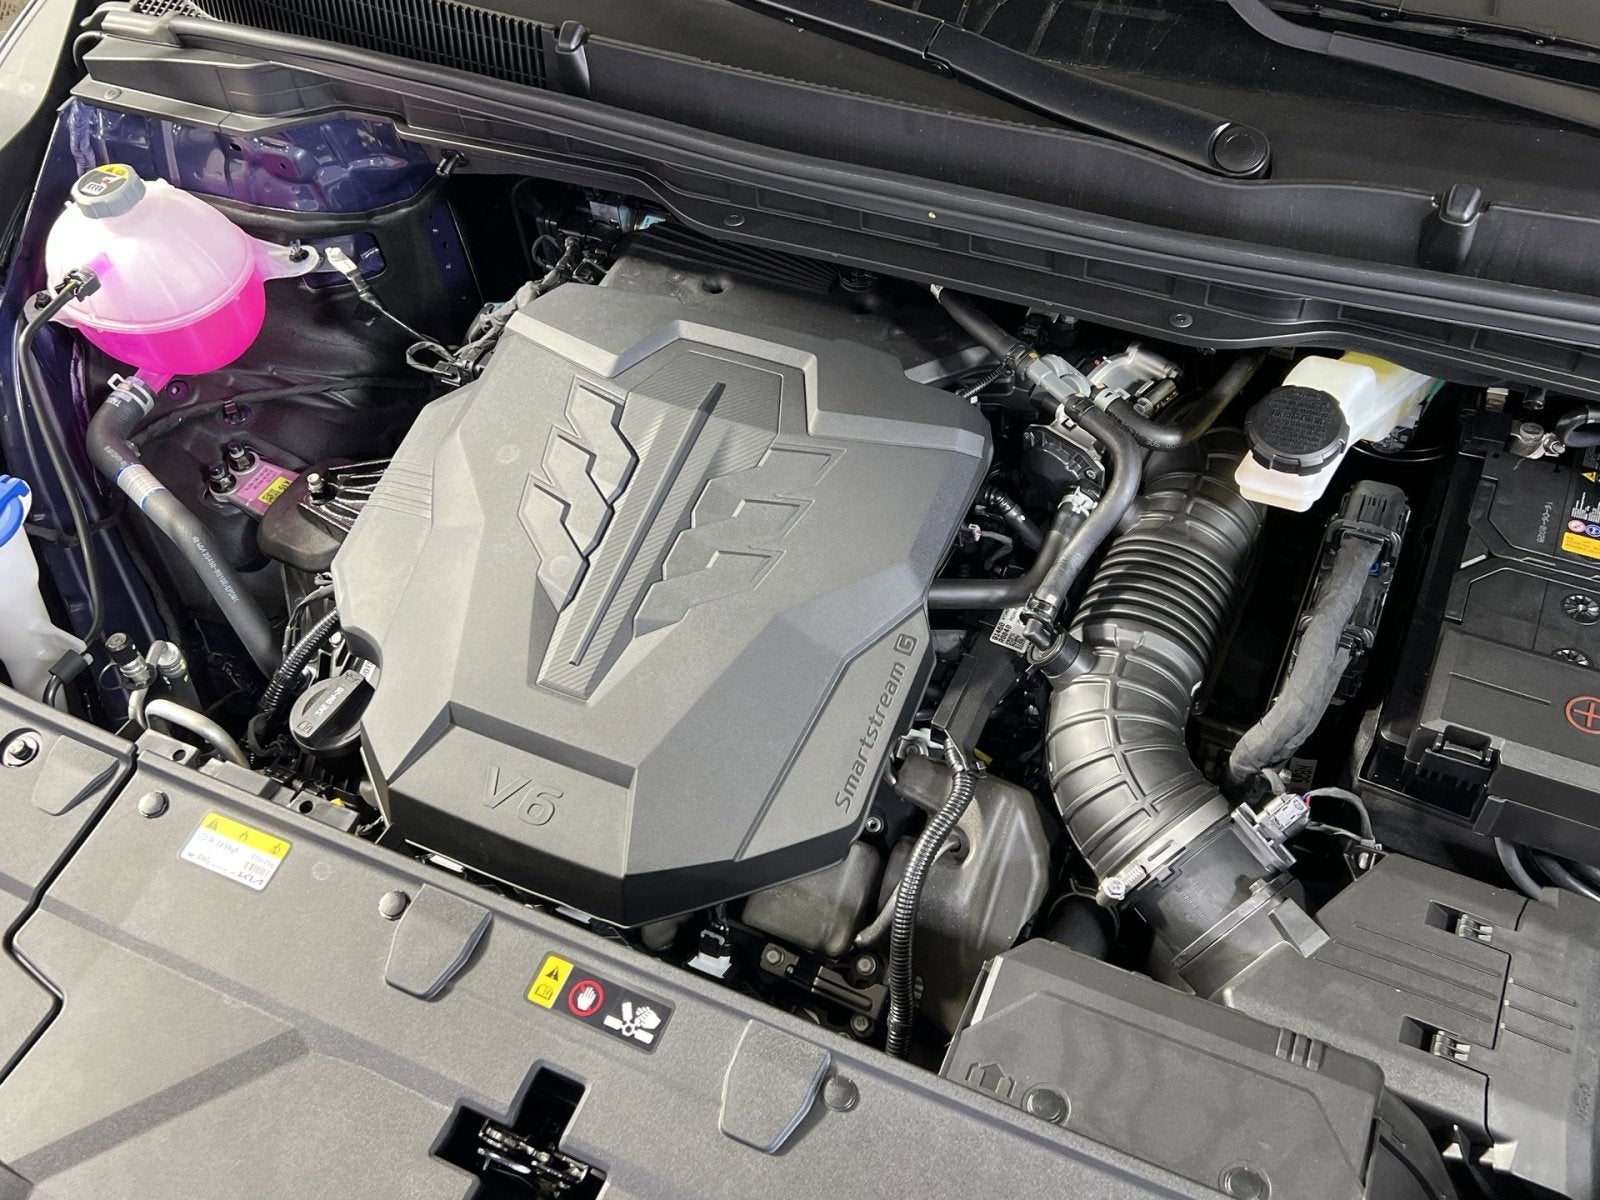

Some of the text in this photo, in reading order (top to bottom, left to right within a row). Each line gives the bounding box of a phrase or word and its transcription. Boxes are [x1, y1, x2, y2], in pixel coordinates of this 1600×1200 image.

[834, 661, 907, 814] Smartstream
[484, 762, 565, 827] V6
[238, 871, 264, 886] KIA
